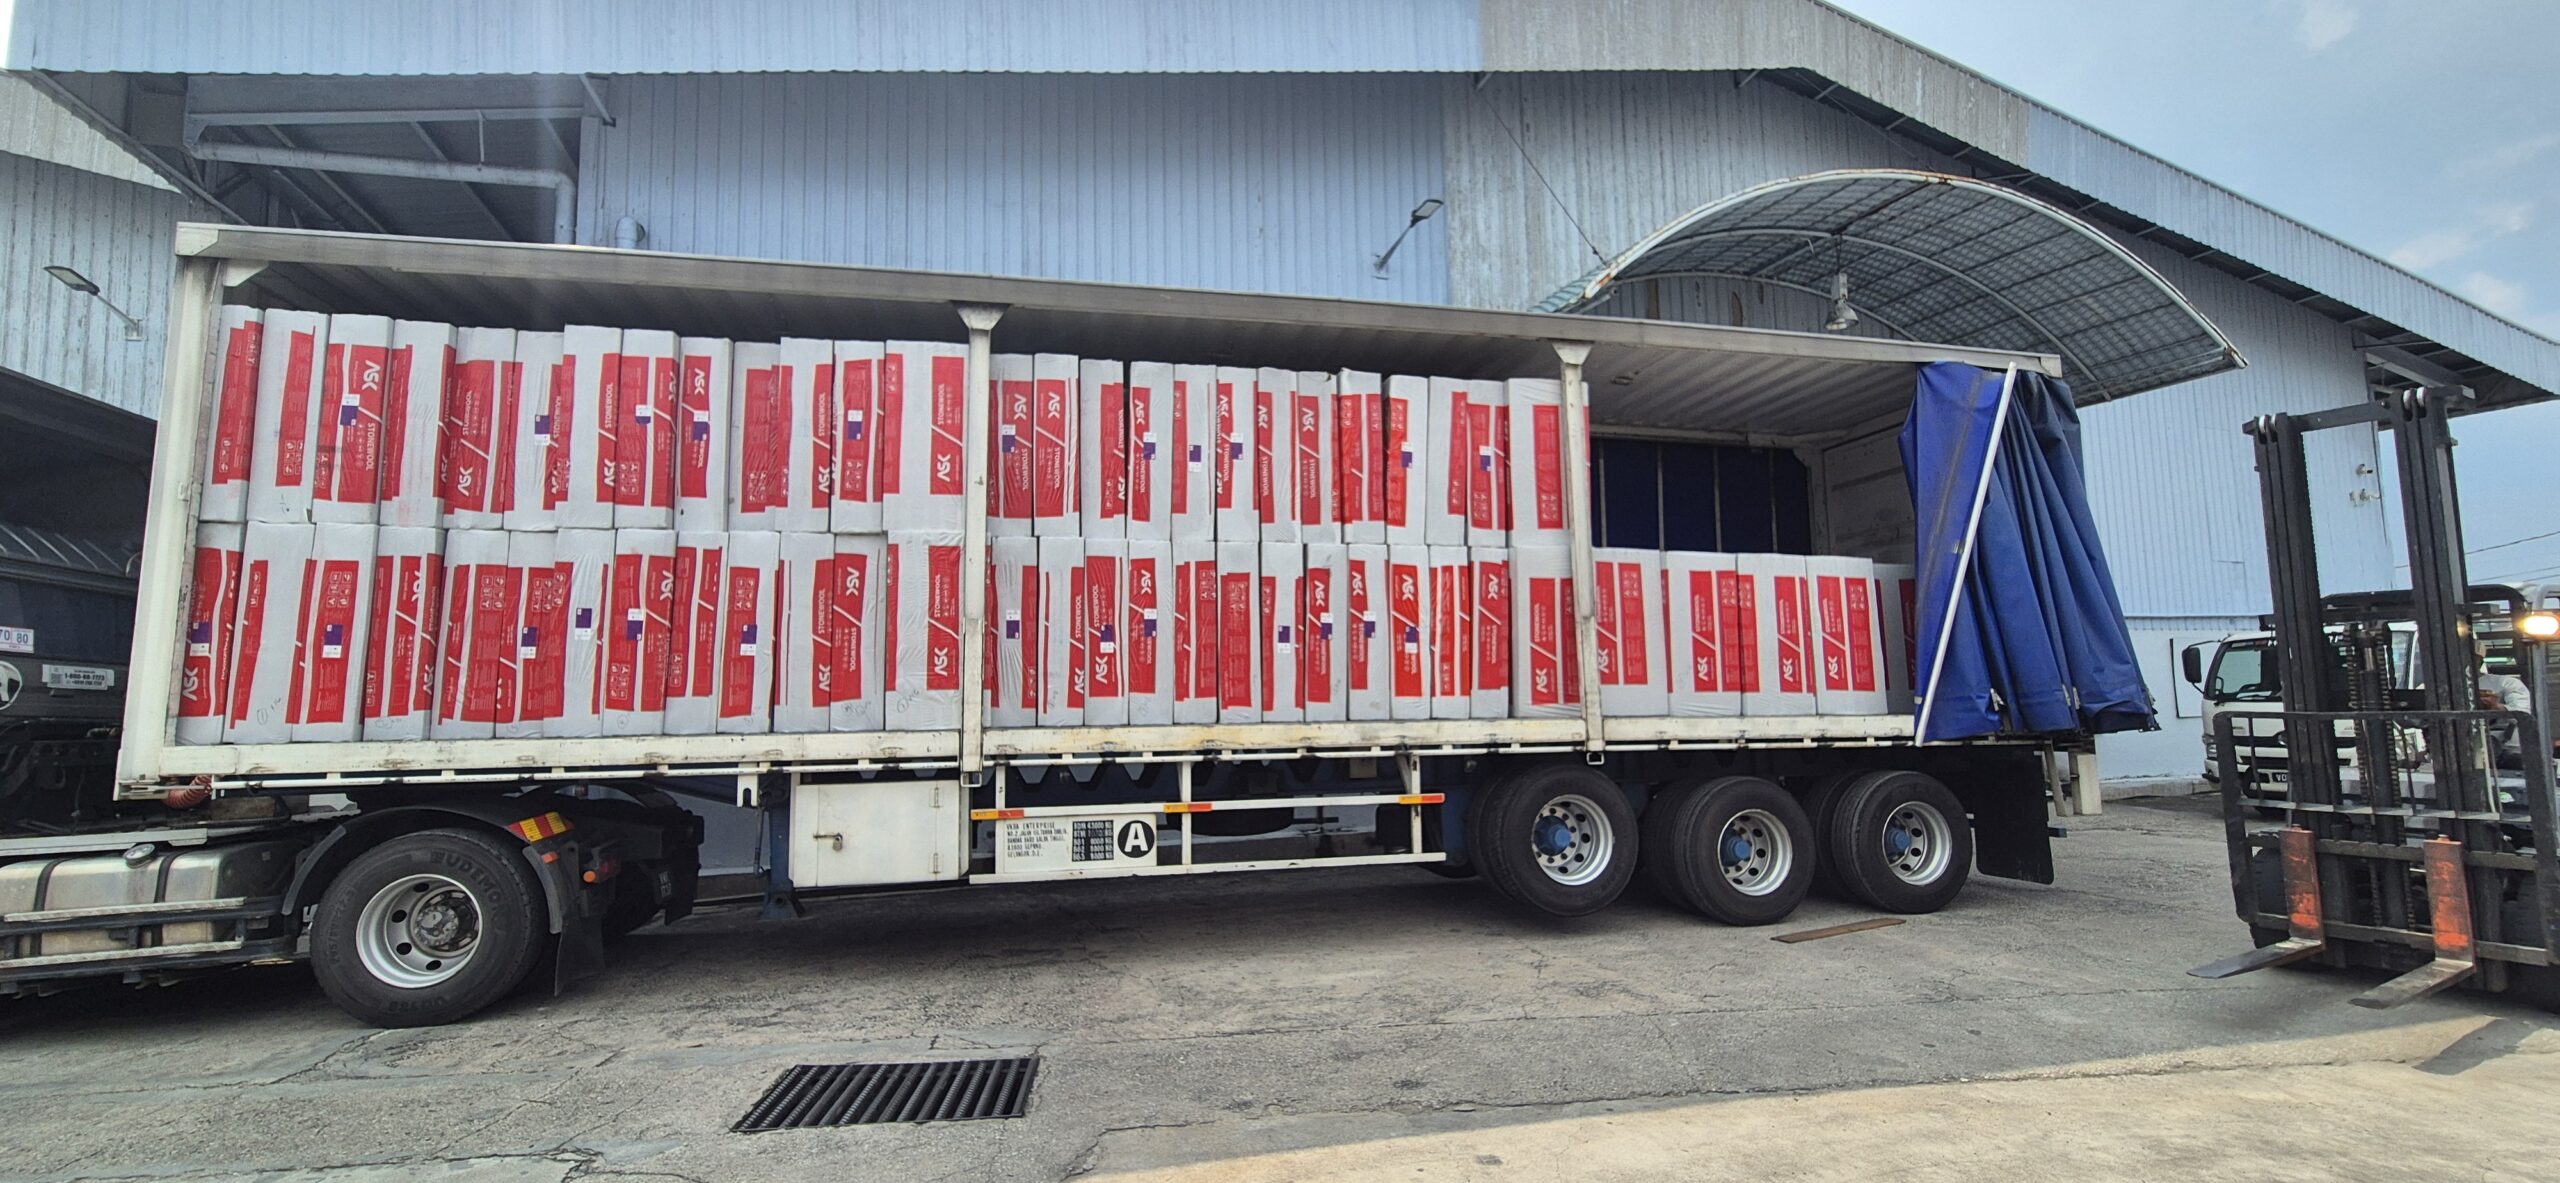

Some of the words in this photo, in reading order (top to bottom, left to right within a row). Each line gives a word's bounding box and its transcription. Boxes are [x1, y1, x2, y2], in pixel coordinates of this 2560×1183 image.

[362, 359, 381, 391] ASK
[694, 368, 705, 396] ASK
[463, 390, 472, 435] STONEWOOL
[605, 382, 613, 428] STONEWOOL
[819, 392, 827, 437] STONEWOOL
[937, 383, 945, 425] STONEWOOL
[1014, 393, 1027, 420] ASK
[1048, 391, 1060, 419] ASK
[1134, 400, 1145, 425] ASK
[1302, 407, 1315, 432] ASK
[366, 422, 376, 471] STONEWOOL
[457, 466, 473, 497] ASK
[937, 453, 951, 482] ASK
[846, 567, 860, 596] ASK
[1141, 569, 1151, 595] ASK
[1402, 574, 1415, 601] ASK
[16, 633, 28, 643] 80
[934, 647, 948, 677] ASK
[1095, 656, 1108, 684] ASK
[1697, 656, 1708, 681] ASK
[1783, 658, 1794, 682] ASK
[1828, 656, 1839, 680] ASK
[183, 666, 199, 701] ASK
[1535, 668, 1548, 694] ASK
[1023, 822, 1055, 830] ENTERPRISE
[1124, 823, 1149, 853] A
